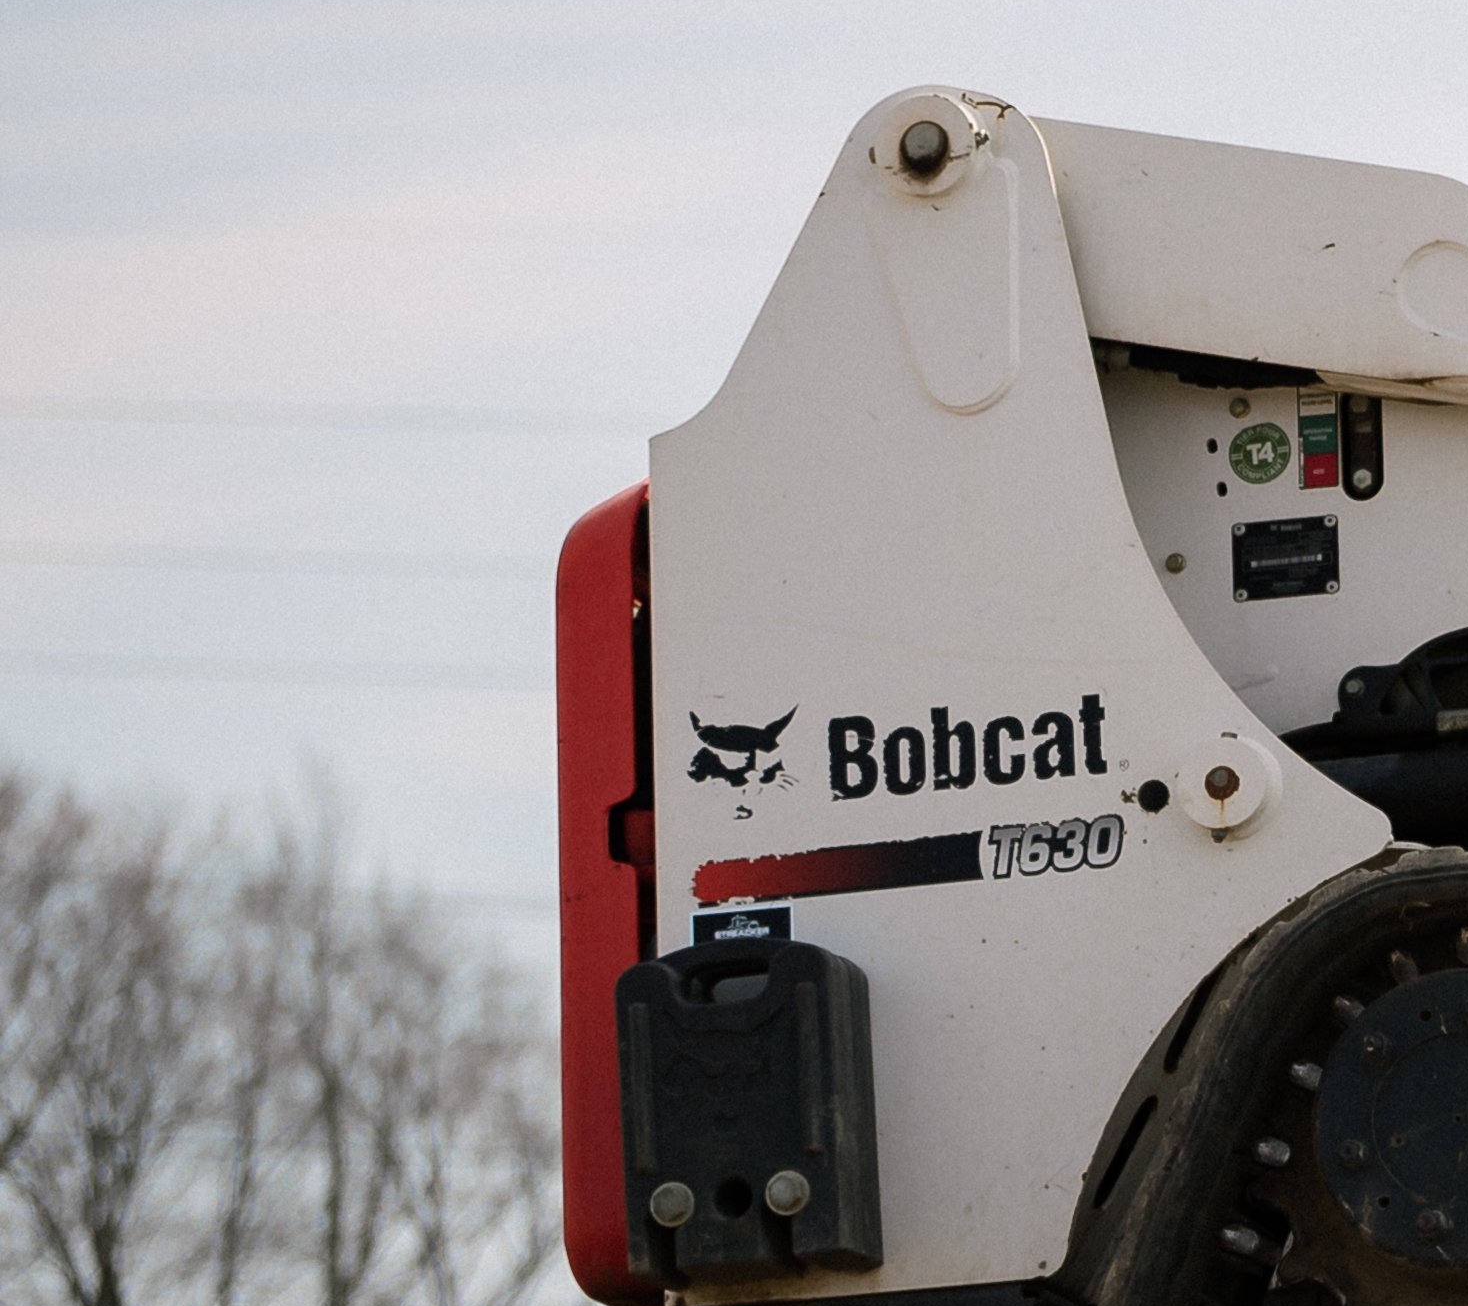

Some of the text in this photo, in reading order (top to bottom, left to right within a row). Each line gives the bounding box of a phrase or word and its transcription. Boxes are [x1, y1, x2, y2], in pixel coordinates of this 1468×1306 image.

[1236, 458, 1284, 480] COMPLIANT
[1245, 441, 1275, 465] T4
[828, 693, 1108, 802] Bobcat
[988, 813, 1124, 880] T630
